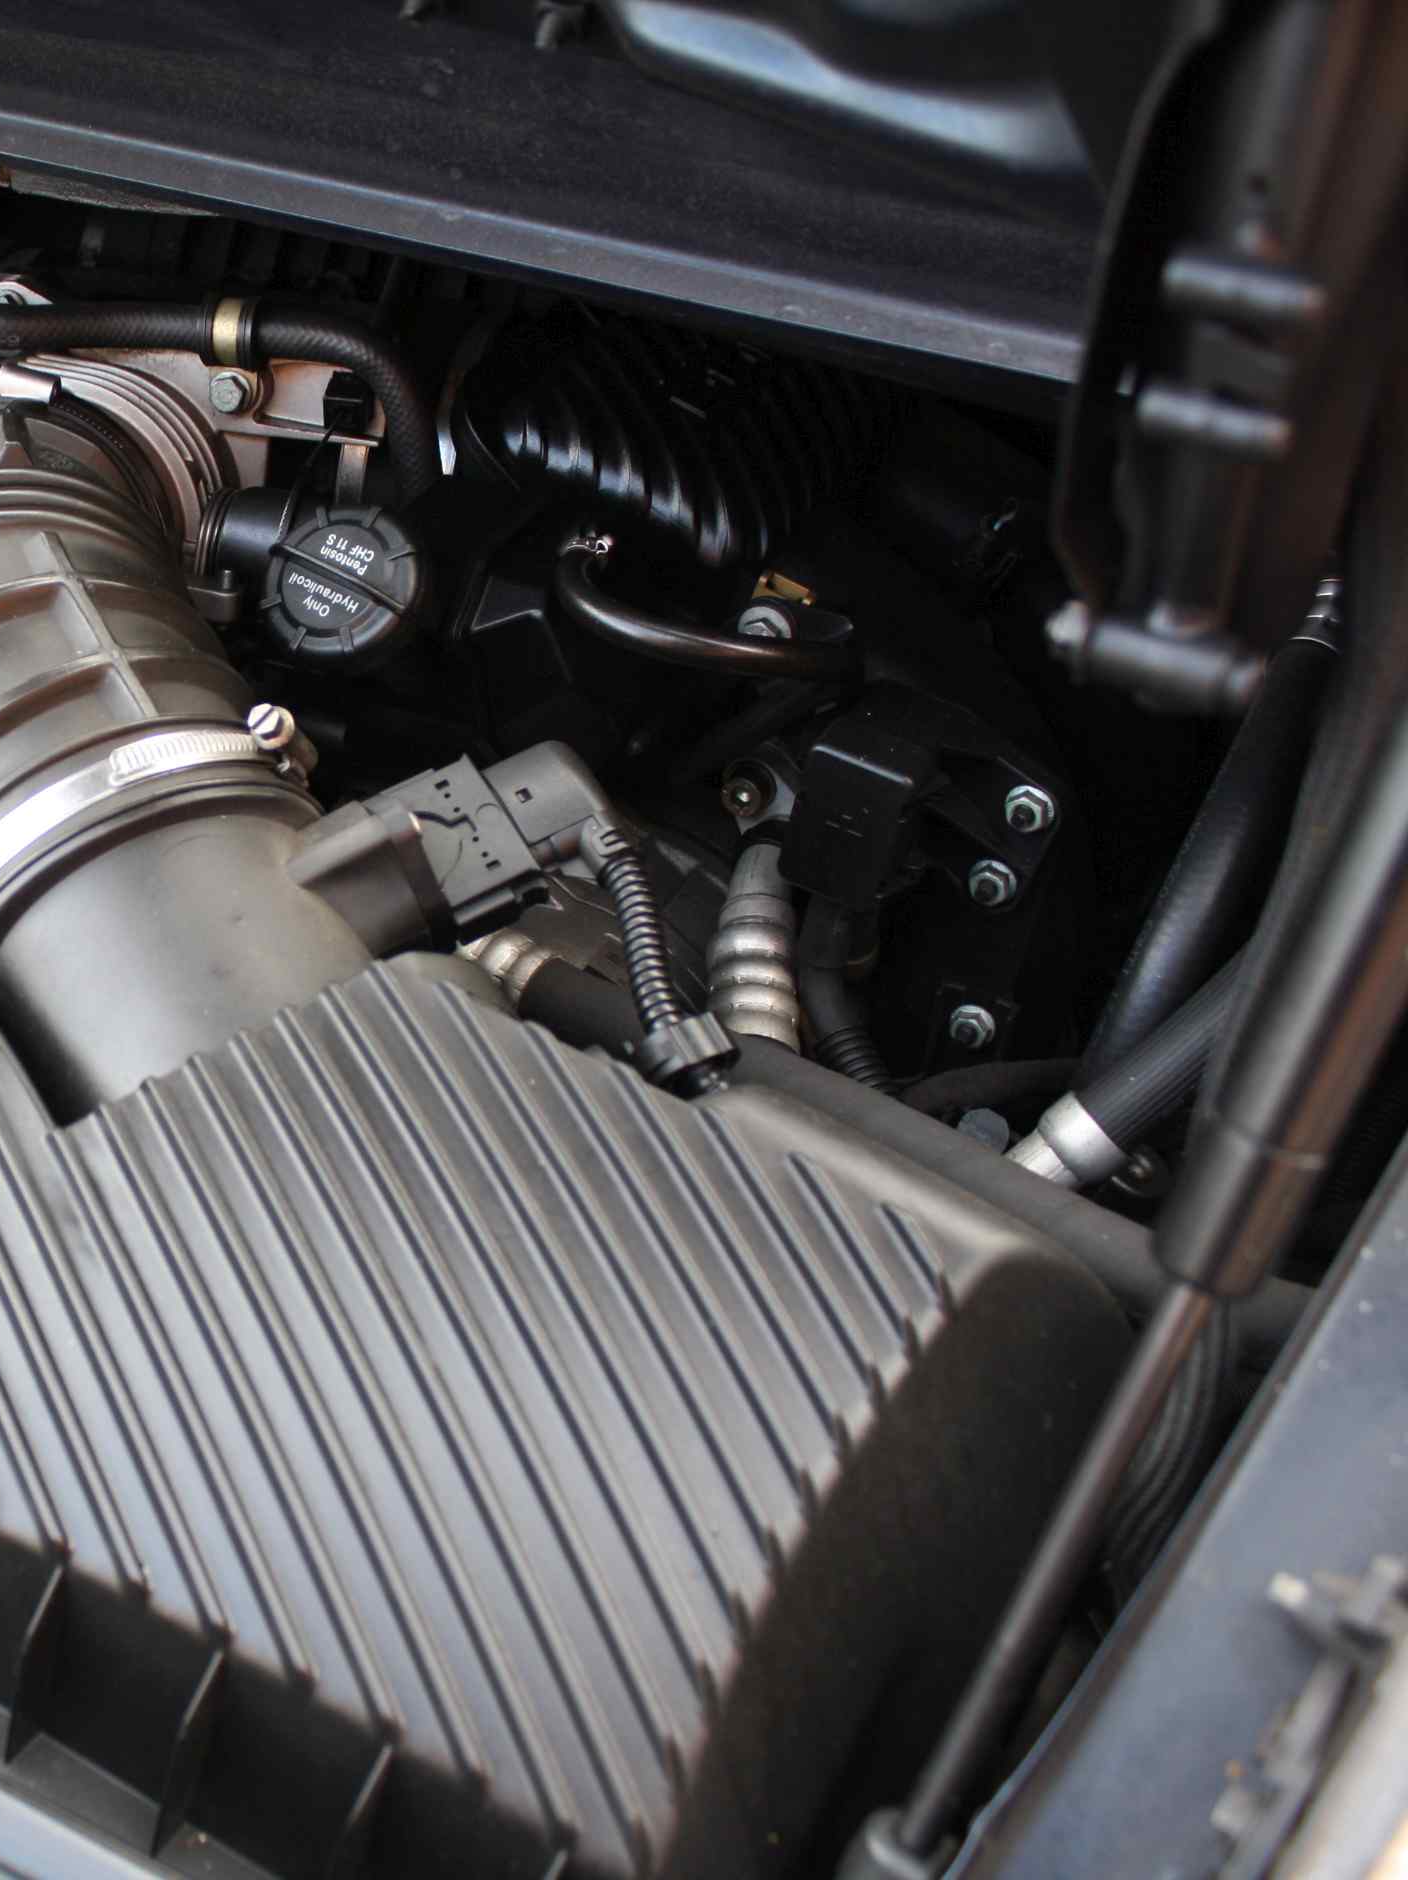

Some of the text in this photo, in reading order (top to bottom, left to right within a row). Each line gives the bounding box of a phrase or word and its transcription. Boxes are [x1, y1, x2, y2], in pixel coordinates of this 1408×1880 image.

[326, 534, 337, 545] S
[320, 545, 368, 576] Pentosin
[349, 545, 375, 562] CHF
[288, 572, 360, 613] Hydraulicoil
[303, 595, 330, 617] Only
